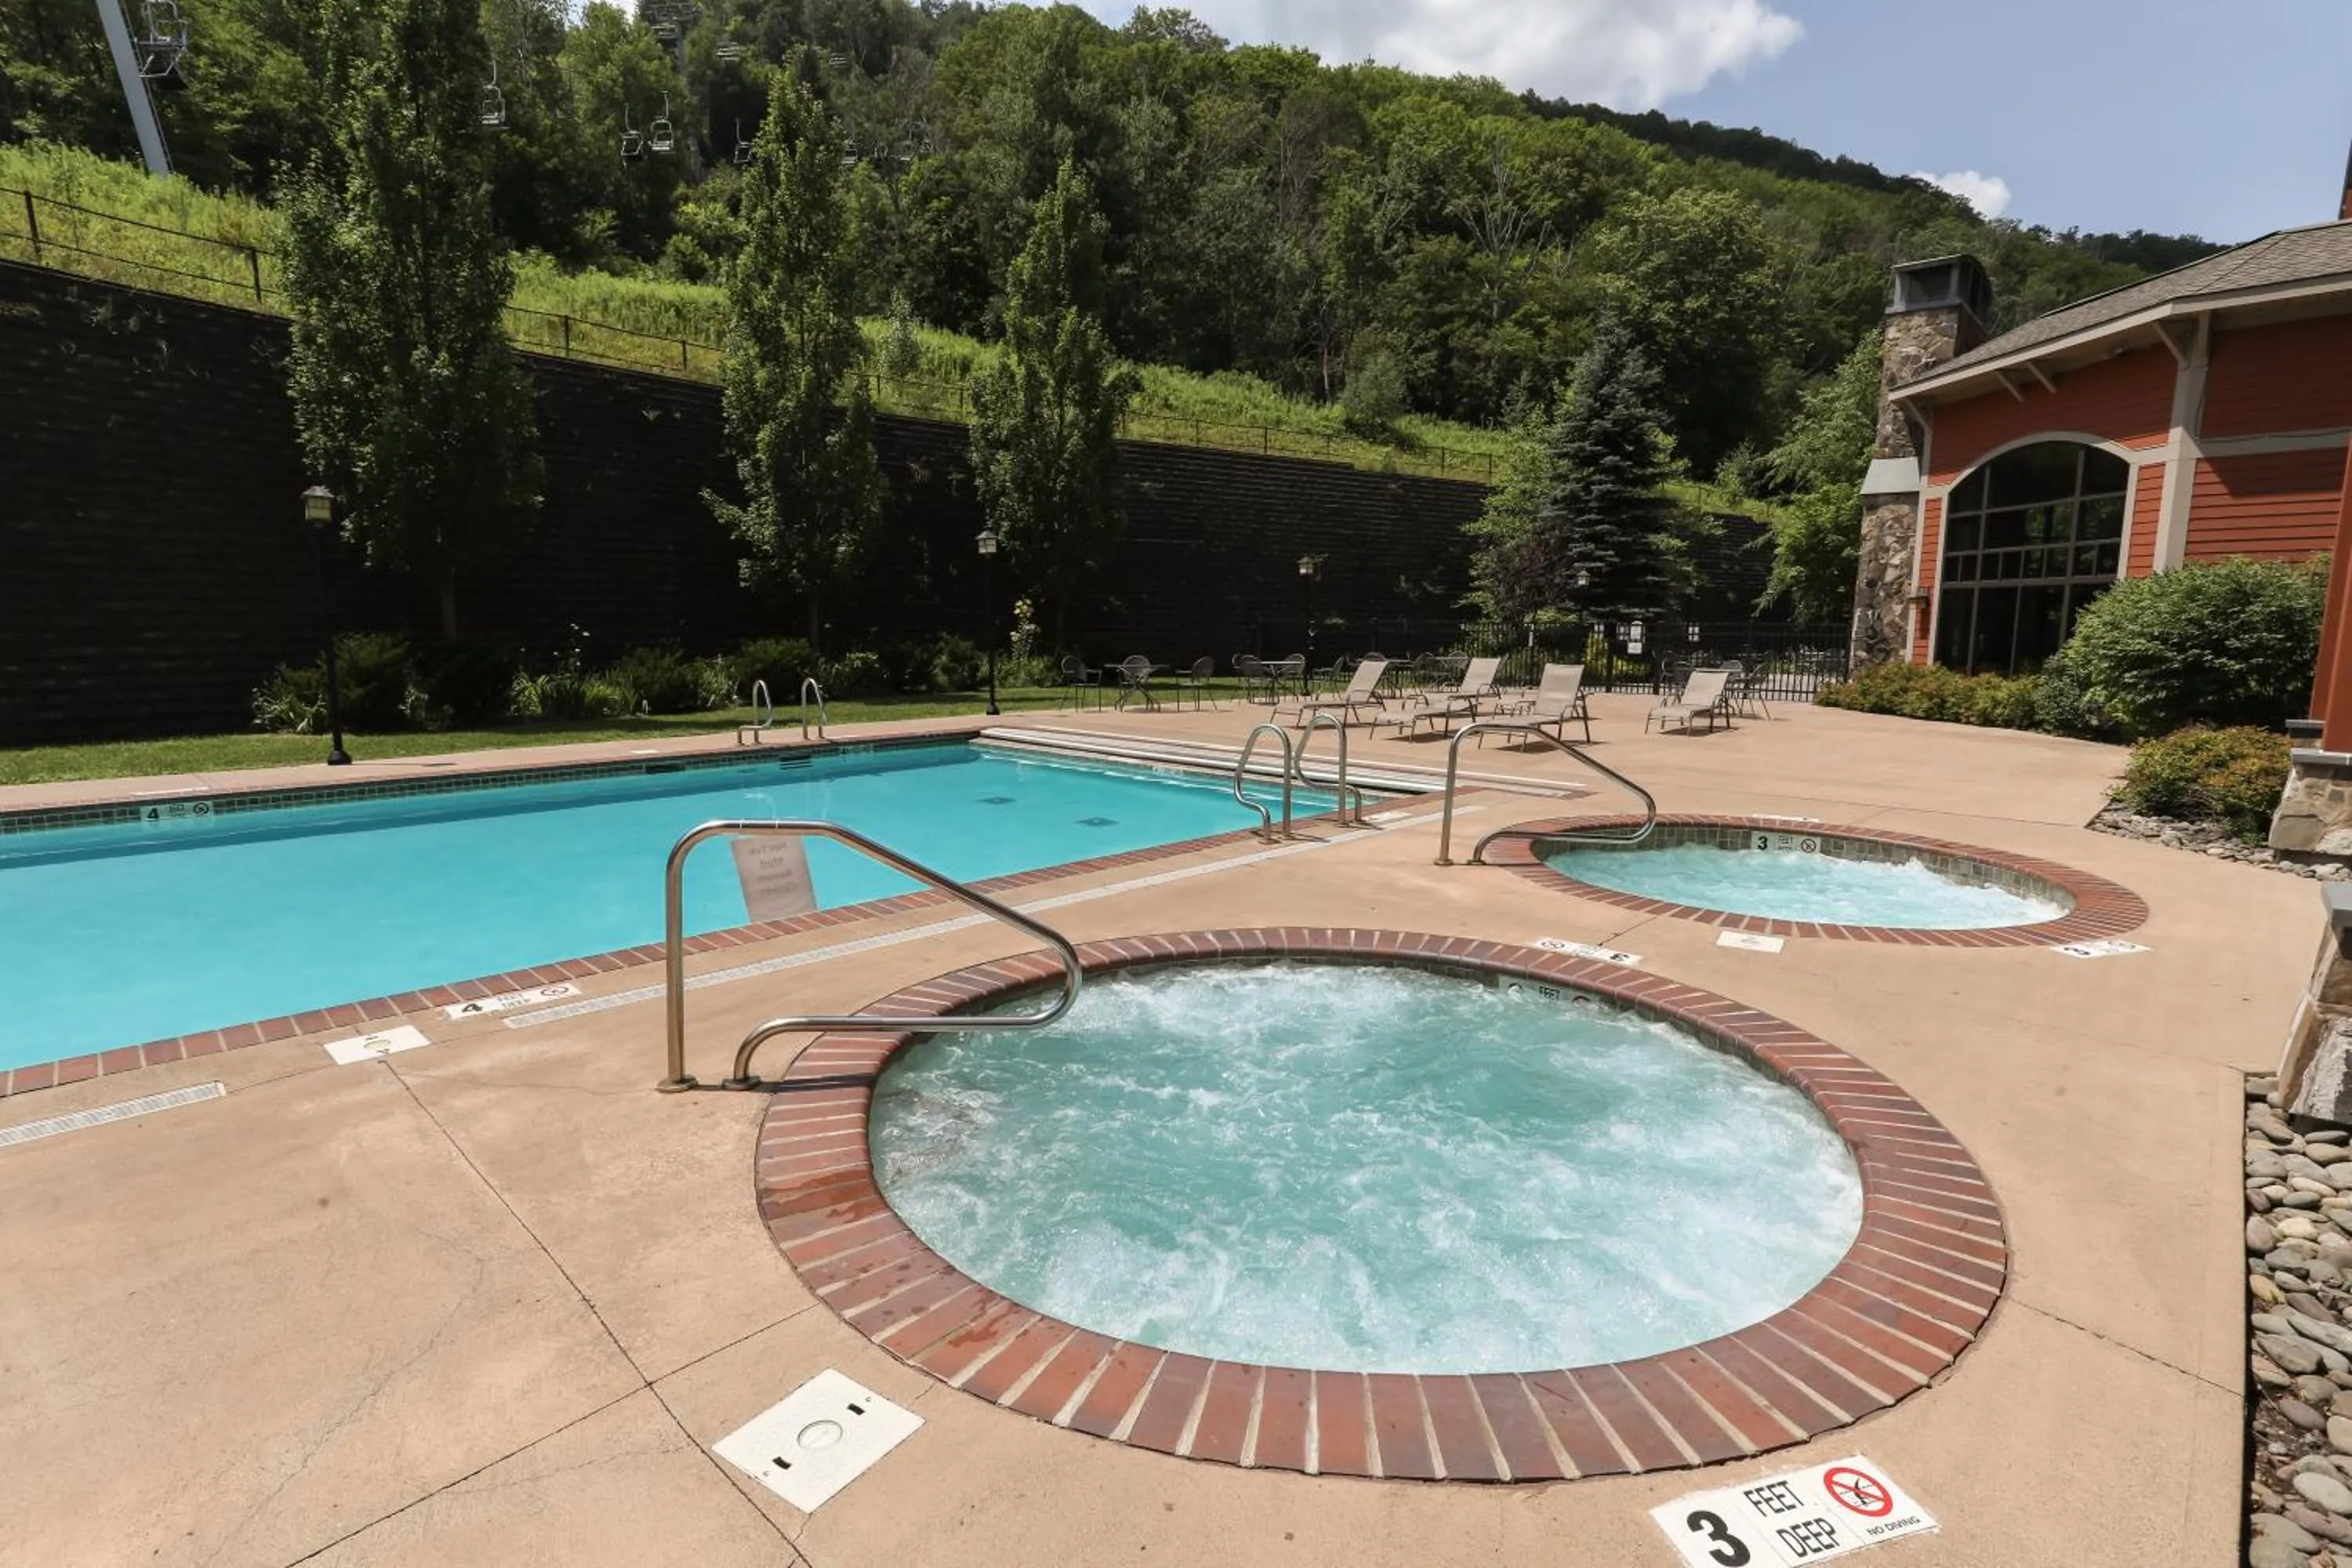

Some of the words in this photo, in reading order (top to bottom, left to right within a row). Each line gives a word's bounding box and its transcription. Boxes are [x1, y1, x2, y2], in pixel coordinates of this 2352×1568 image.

[147, 807, 159, 818] 4
[1757, 835, 1768, 851] 3
[1539, 985, 1560, 1000] FEET
[461, 1003, 483, 1014] 4
[1743, 1480, 1805, 1517] FEET
[1866, 1525, 1885, 1536] NO
[1884, 1515, 1921, 1532] DIVING
[1686, 1510, 1750, 1567] 3
[1776, 1517, 1840, 1558] DEEP
